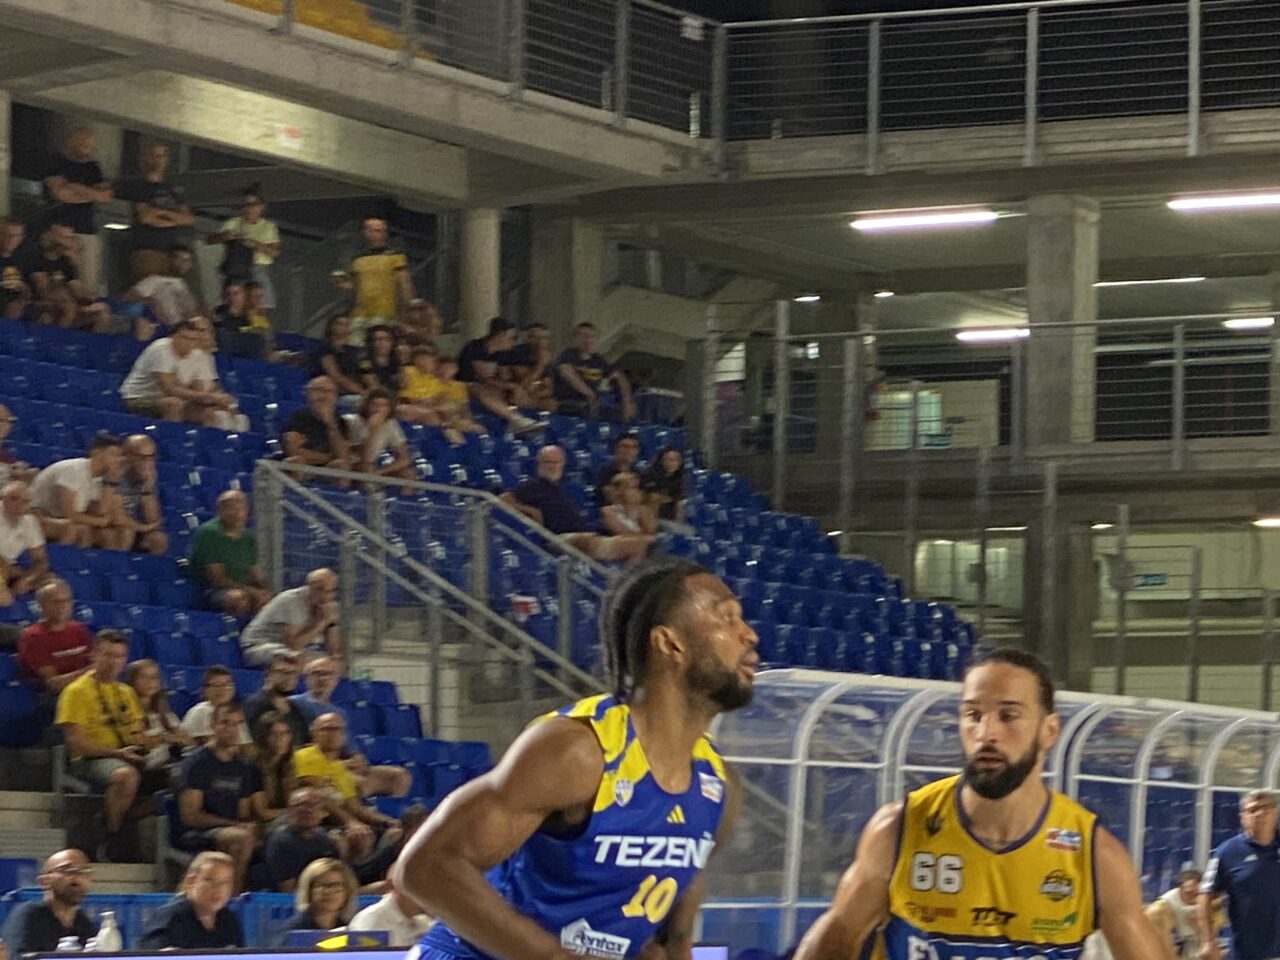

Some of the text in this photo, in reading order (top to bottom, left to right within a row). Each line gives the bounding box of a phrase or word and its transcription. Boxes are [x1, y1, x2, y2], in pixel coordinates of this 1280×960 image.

[594, 831, 717, 869] TEZEN
[910, 851, 964, 893] 66
[622, 874, 678, 923] 10
